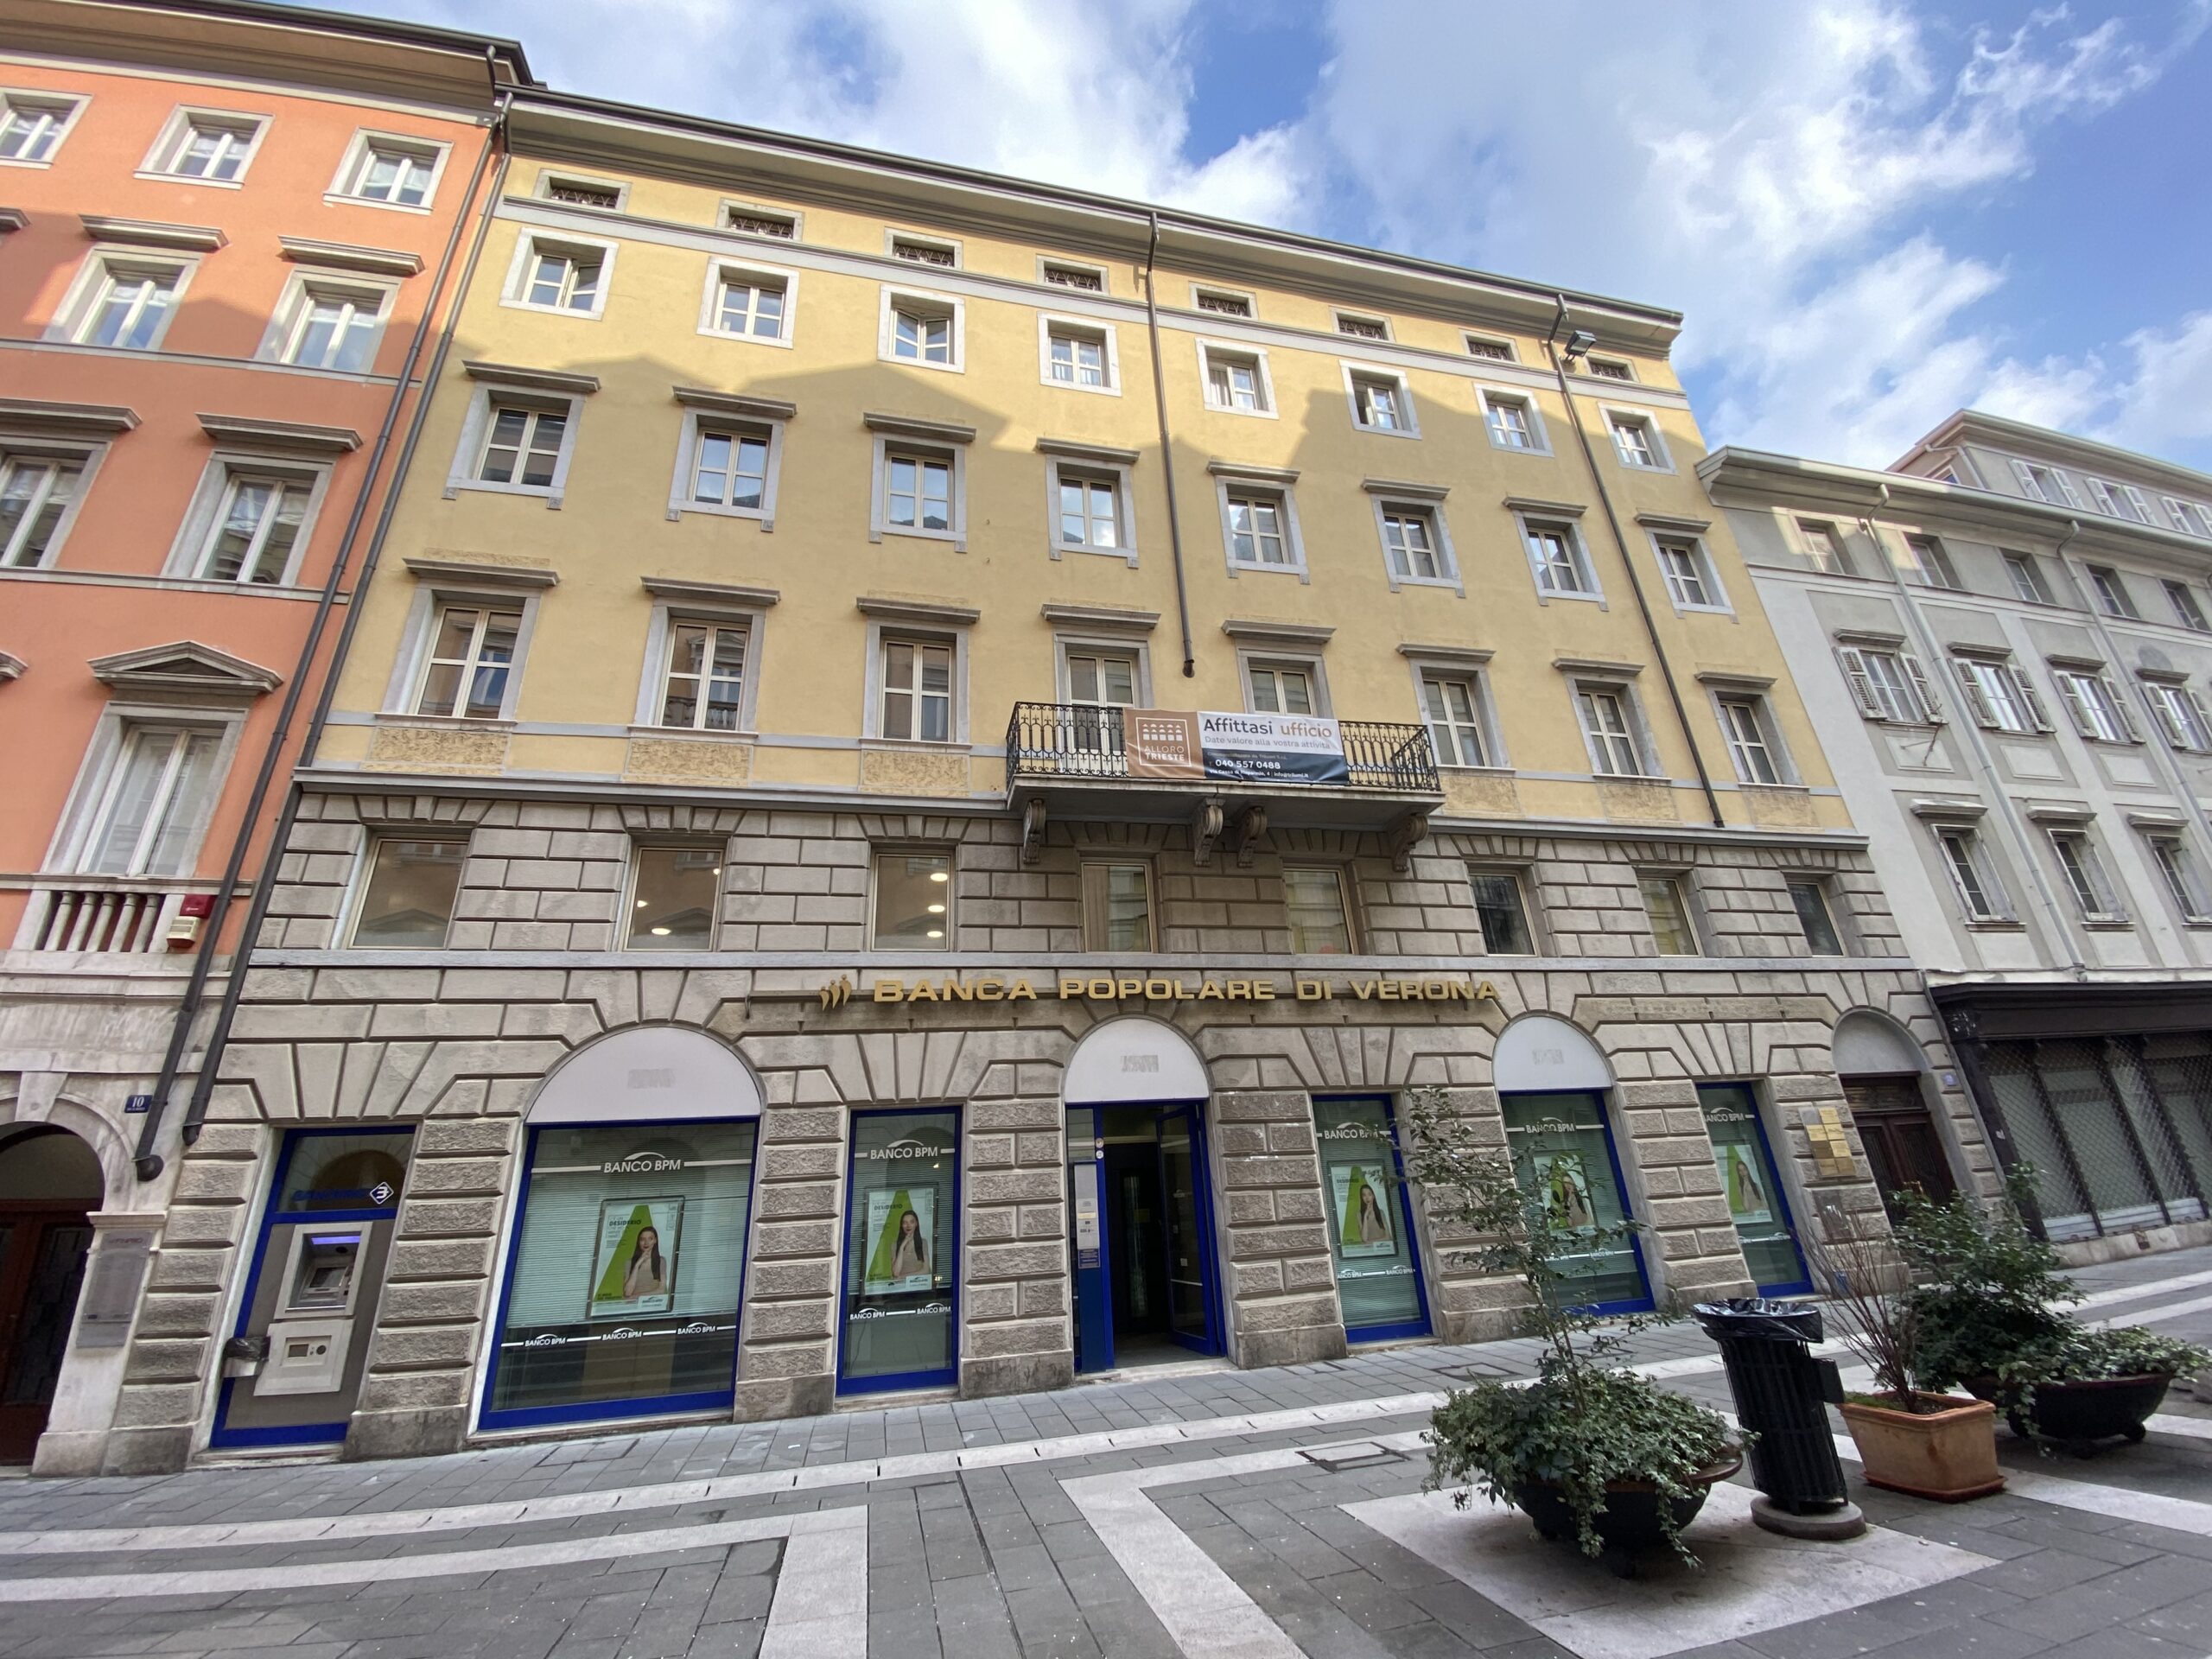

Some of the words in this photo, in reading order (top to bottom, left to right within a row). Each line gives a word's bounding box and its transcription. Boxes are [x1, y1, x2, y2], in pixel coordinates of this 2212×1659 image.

[1204, 718, 1273, 734] Affittasi
[1281, 722, 1332, 738] ufficio
[1255, 737, 1270, 746] alla
[1145, 753, 1185, 761] TRIESTE
[1215, 759, 1234, 767] 040
[874, 978, 1037, 1002] BANCA
[1059, 978, 1275, 1001] POPOLARE
[1297, 980, 1332, 1000] DI
[1348, 980, 1501, 1000] VERONA
[131, 1096, 144, 1108] 10
[1705, 1113, 1728, 1122] ANCO
[1557, 1123, 1575, 1133] BPM
[1324, 1128, 1357, 1140] BANCO
[870, 1147, 912, 1160] BANCO
[915, 1147, 938, 1158] BPM
[604, 1160, 652, 1173] BANCO
[654, 1159, 682, 1172] BPM
[917, 1306, 938, 1315] BANCO
[849, 1312, 873, 1320] BANCO
[677, 1325, 702, 1335] BANCO
[702, 1325, 715, 1333] BPM
[602, 1332, 627, 1341] BANCO
[627, 1331, 642, 1339] BPM
[524, 1338, 550, 1347] BANCO
[551, 1337, 565, 1345] BPM
